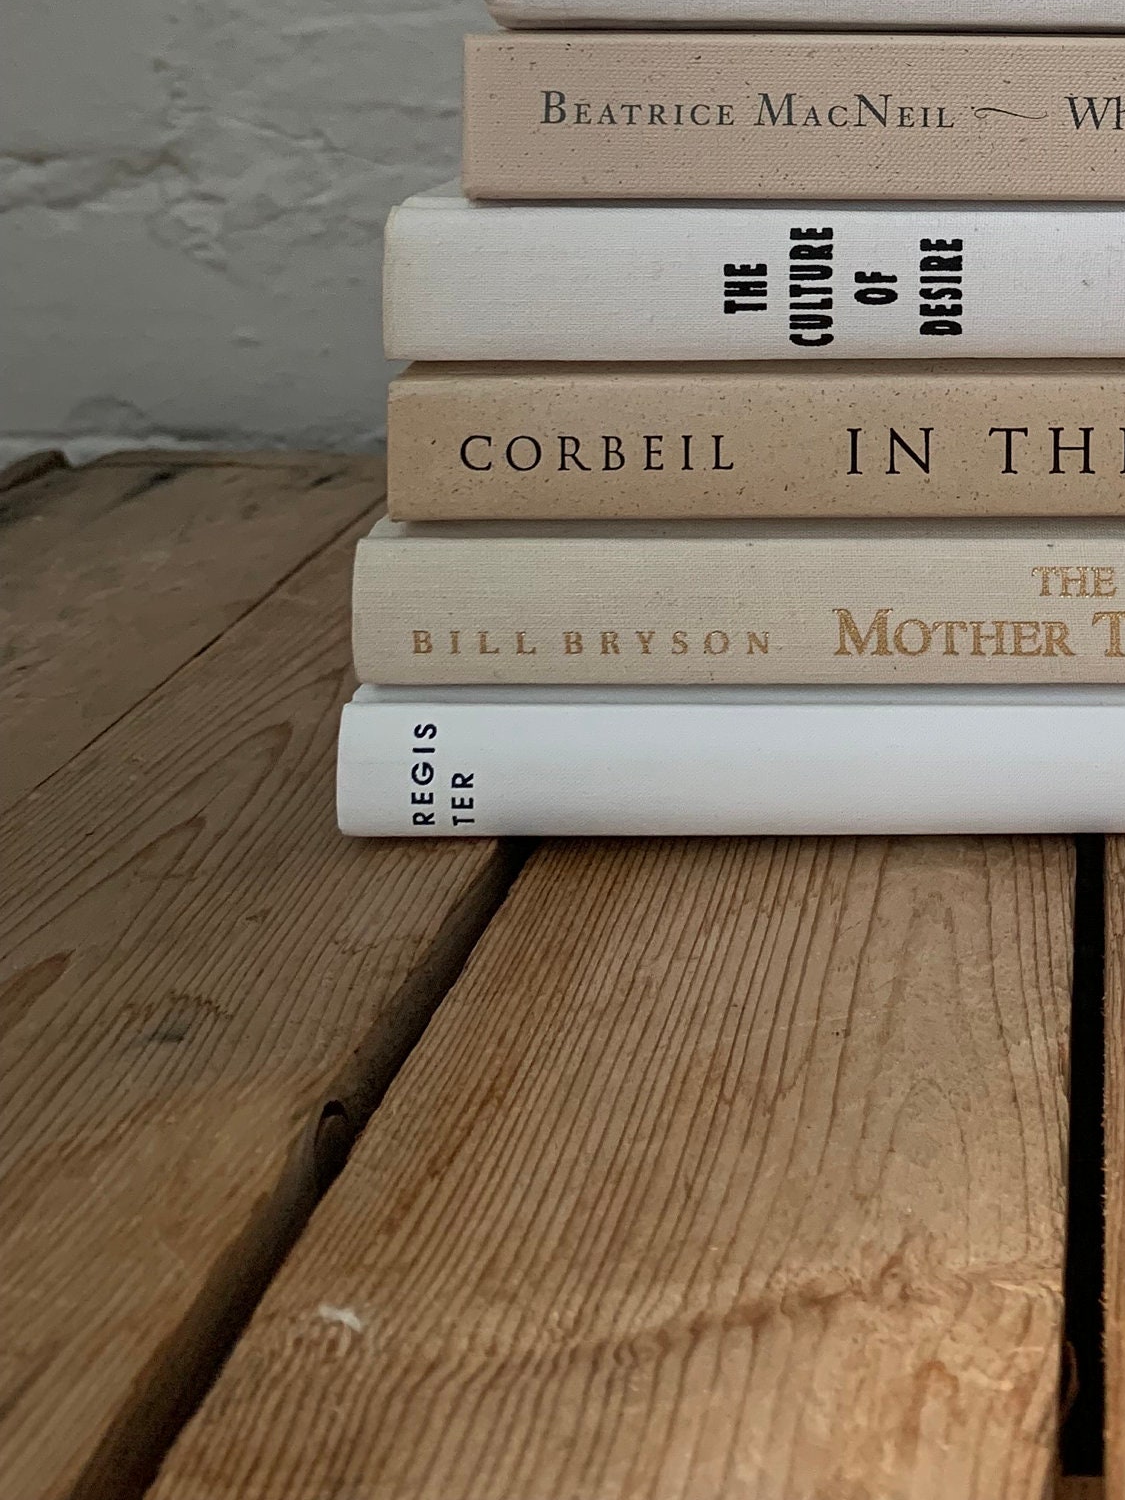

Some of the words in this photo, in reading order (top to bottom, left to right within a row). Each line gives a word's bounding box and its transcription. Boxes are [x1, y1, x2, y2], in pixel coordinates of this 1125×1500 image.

[724, 262, 768, 315] THE
[789, 227, 834, 347] CULTURE
[854, 270, 898, 306] OF
[919, 238, 963, 336] DESIRE
[459, 434, 735, 472] CORBEIL
[846, 427, 935, 476] IN
[1031, 566, 1116, 598] THE
[412, 629, 538, 656] BILL
[564, 629, 771, 656] BRYSON
[411, 722, 437, 827] REGIS
[451, 771, 475, 827] TER
